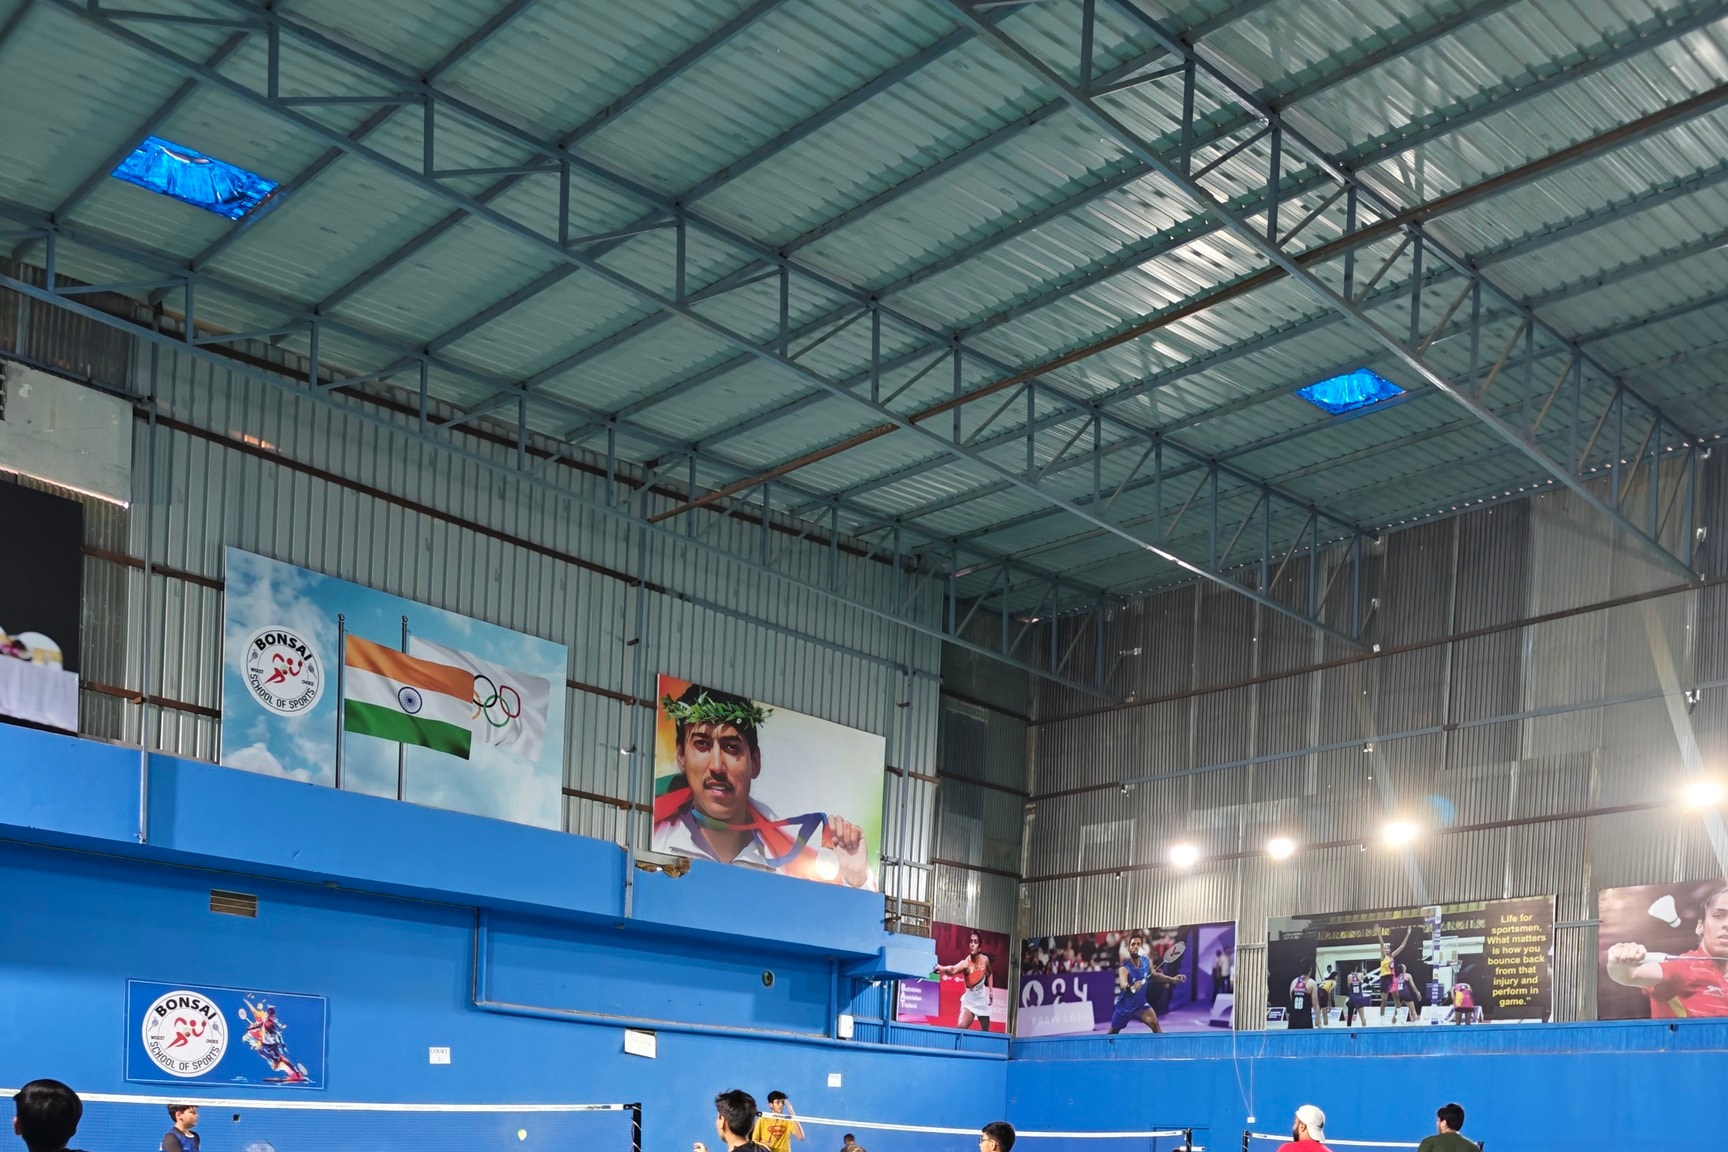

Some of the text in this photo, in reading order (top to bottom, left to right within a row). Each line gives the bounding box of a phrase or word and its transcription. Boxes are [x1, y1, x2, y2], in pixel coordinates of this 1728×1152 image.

[255, 633, 312, 661] BONSAI
[250, 673, 315, 709] SCHOOL OF SPORTS
[1501, 913, 1533, 923] Life for
[1491, 924, 1542, 936] sportsmen,
[1487, 934, 1547, 945] What matters
[1492, 945, 1541, 955] is how you
[1487, 954, 1545, 965] bounce back
[1495, 965, 1537, 975] from that
[1493, 975, 1539, 987] injury and
[1492, 986, 1539, 997] perform in
[154, 997, 217, 1020] BONSAI
[150, 1041, 220, 1071] SCHOOL OF SPORTS
